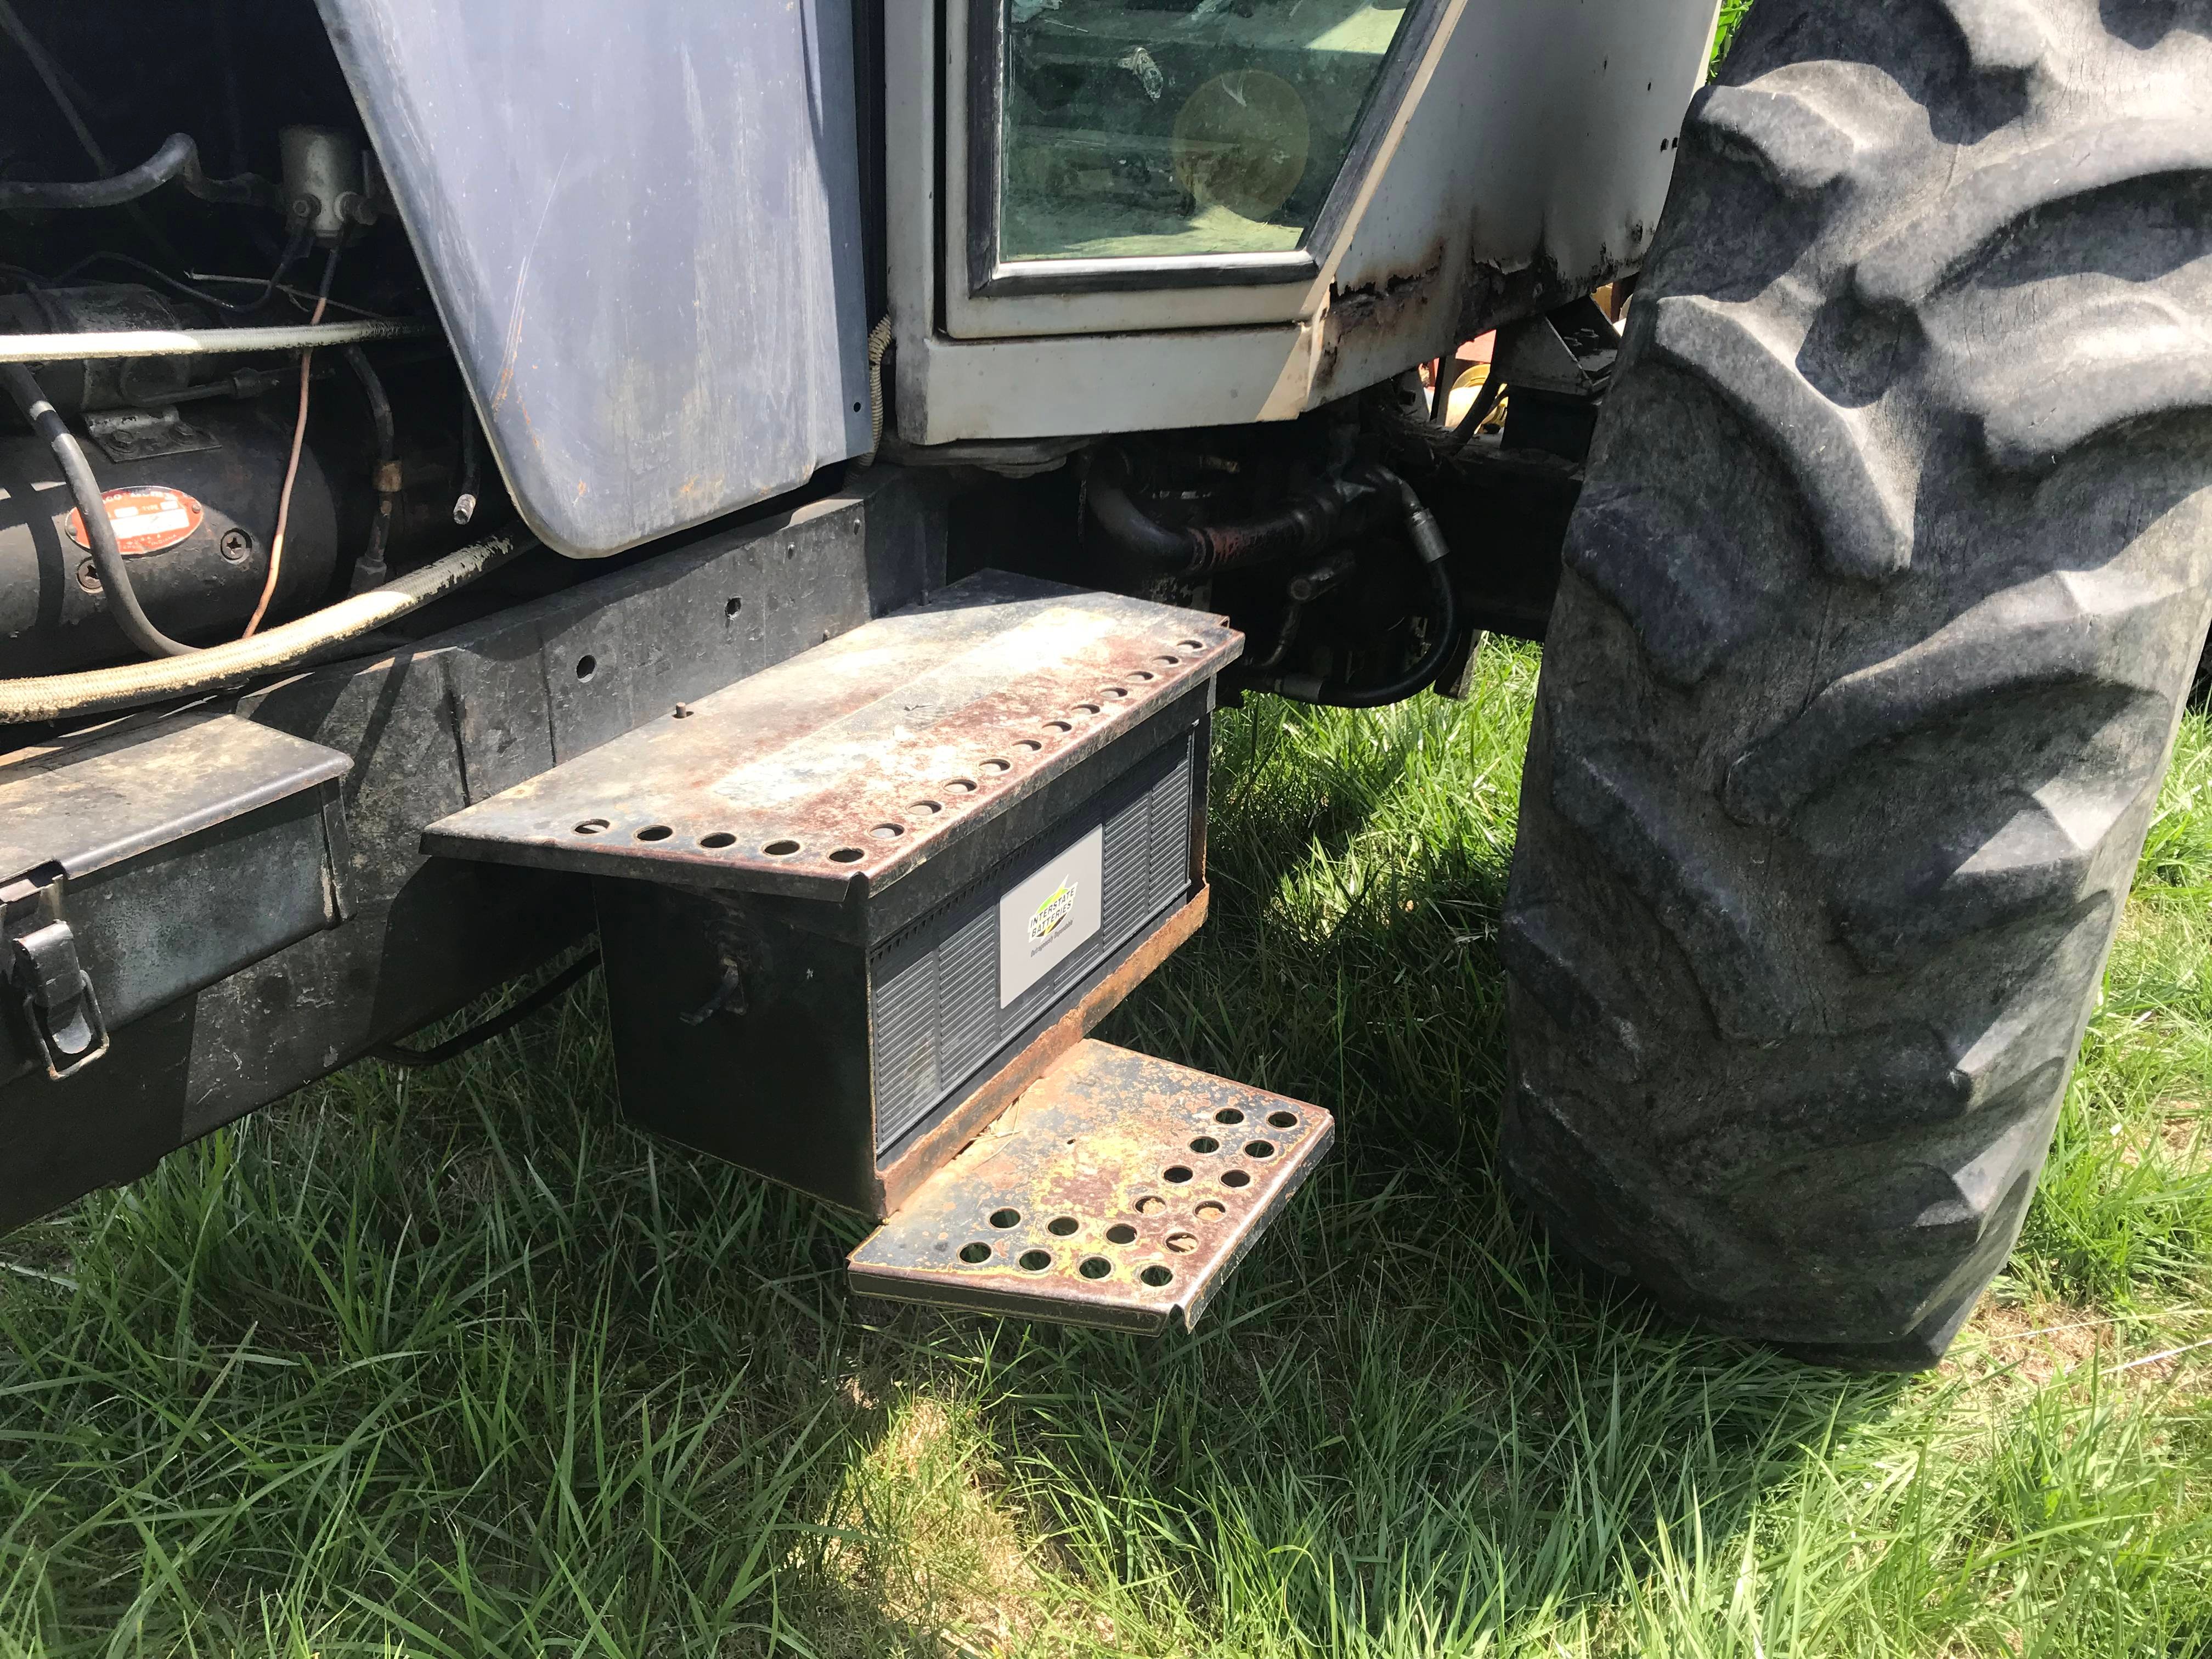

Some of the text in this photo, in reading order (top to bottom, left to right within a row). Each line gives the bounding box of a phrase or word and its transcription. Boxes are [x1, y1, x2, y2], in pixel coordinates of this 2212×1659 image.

[151, 534, 177, 546] INDIANA
[1030, 887, 1075, 928] INTERSTATE
[1031, 900, 1071, 938] BATTERIES
